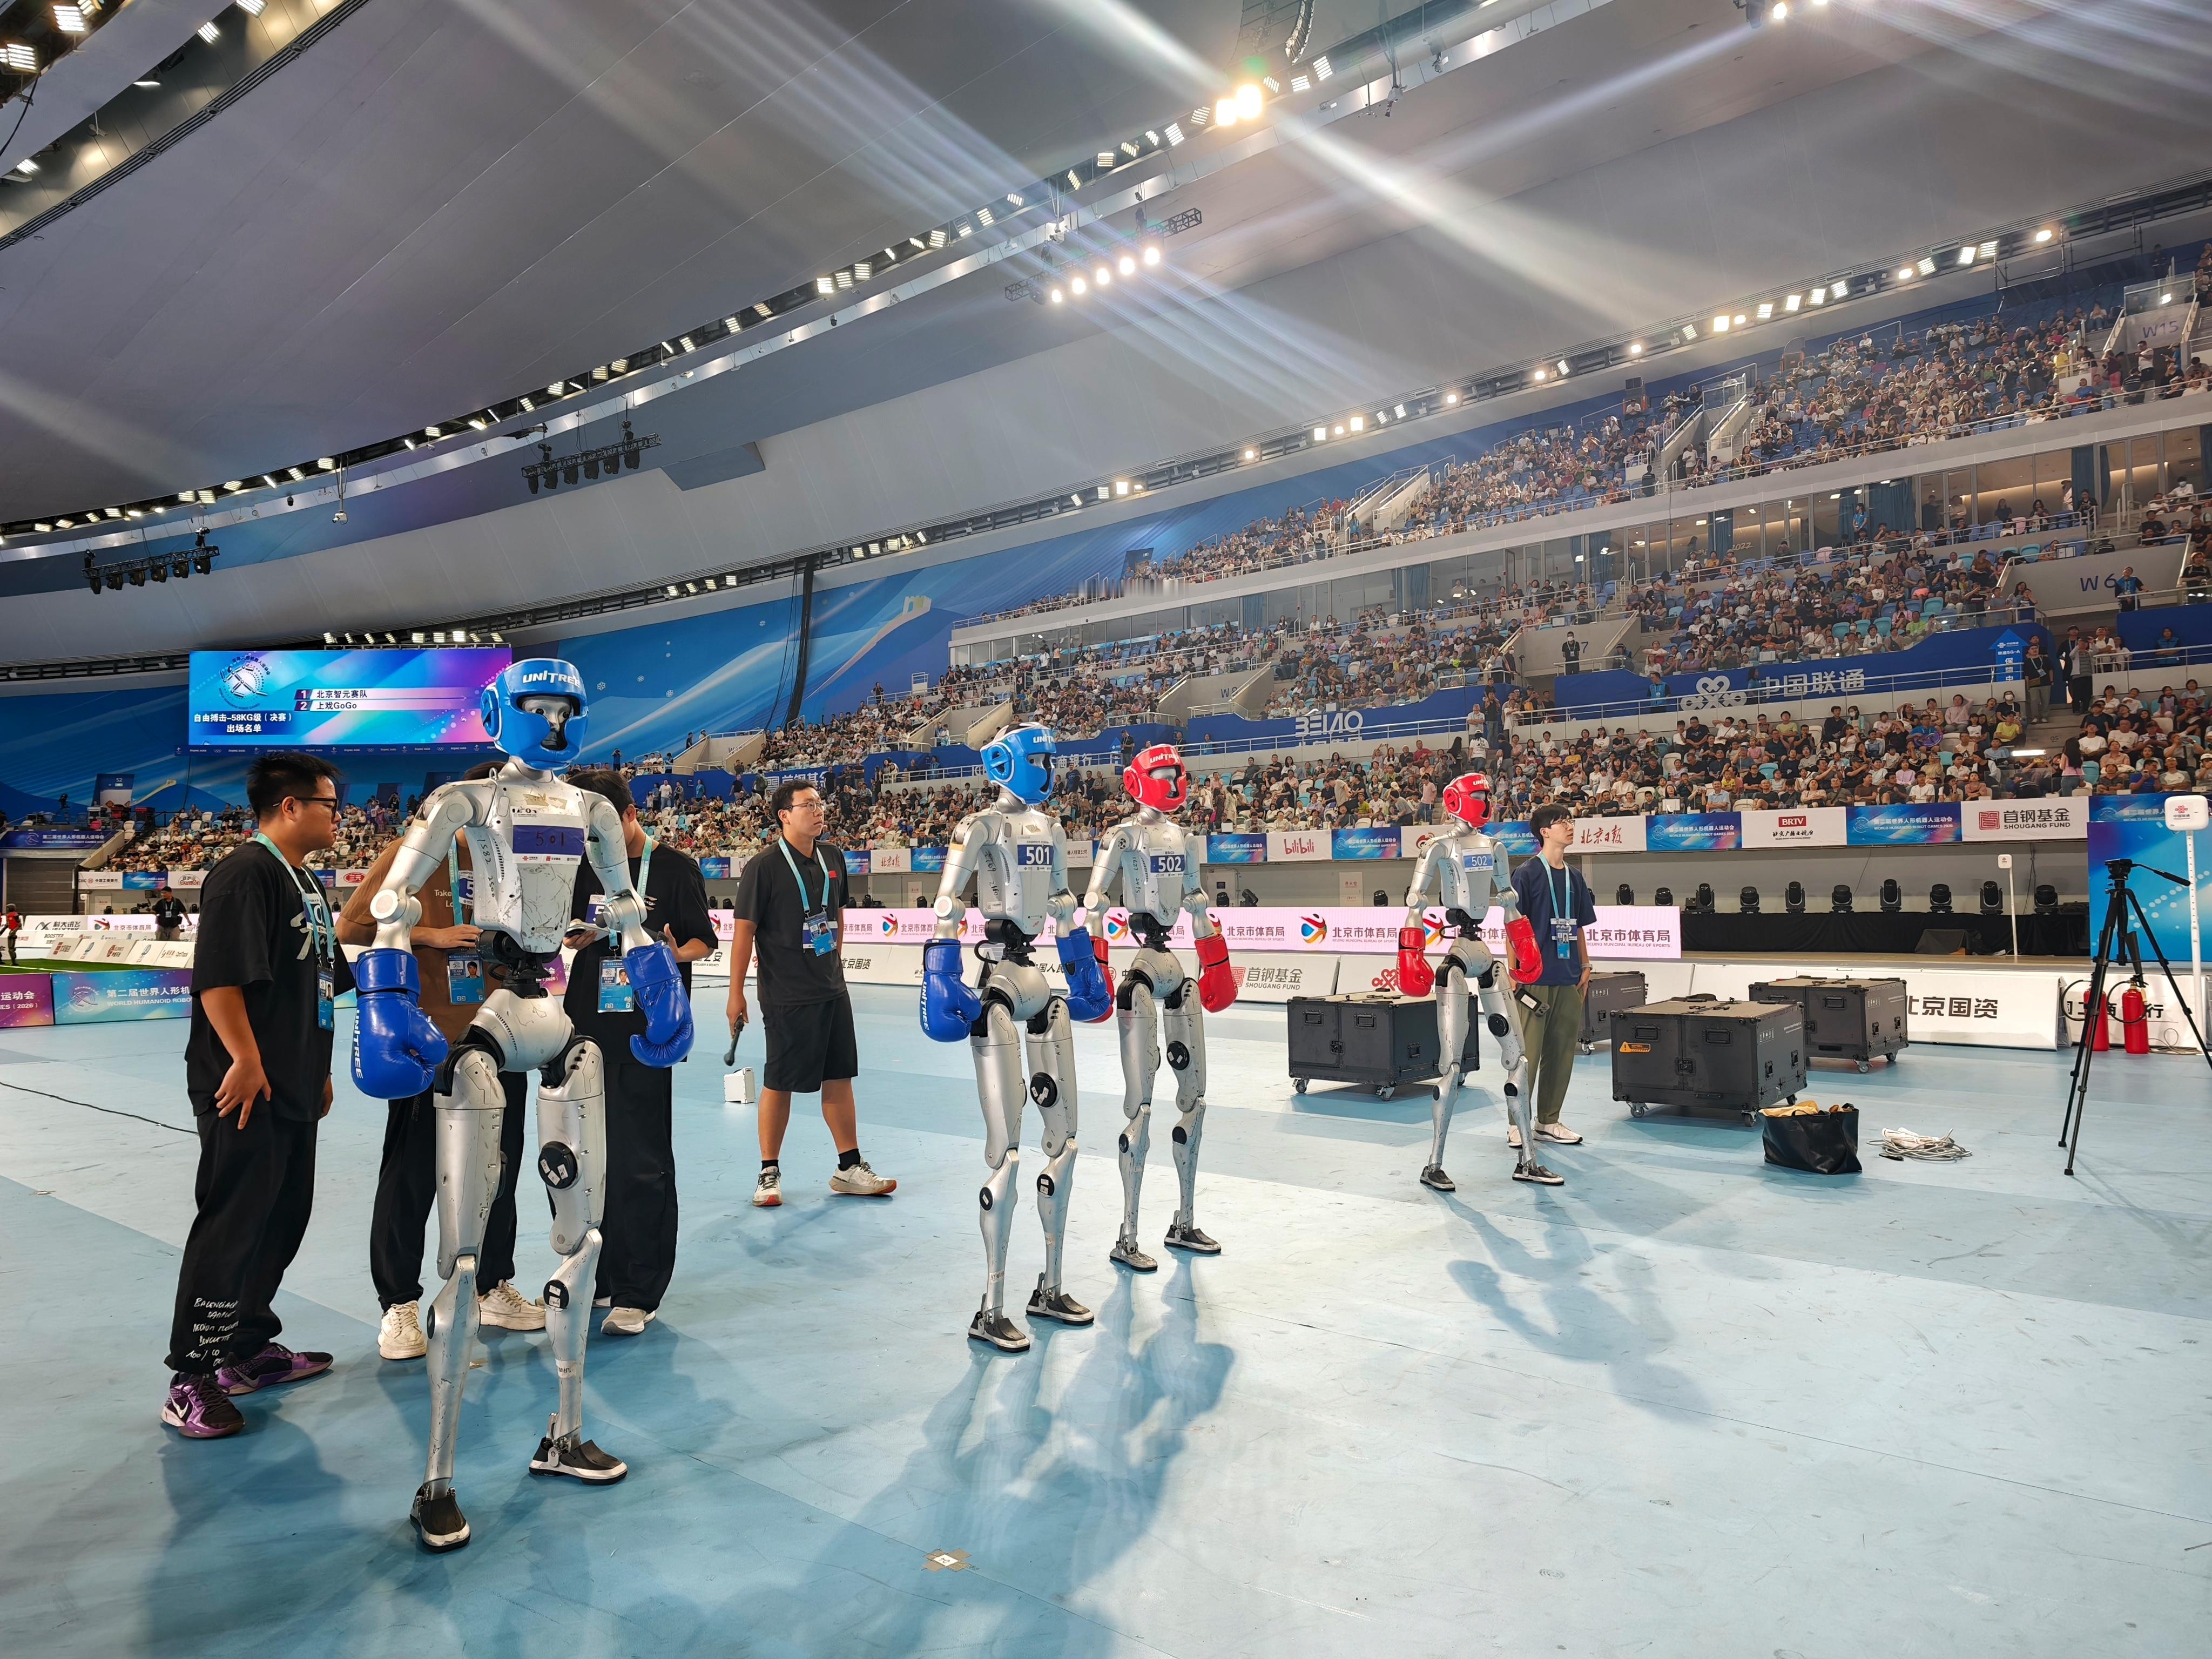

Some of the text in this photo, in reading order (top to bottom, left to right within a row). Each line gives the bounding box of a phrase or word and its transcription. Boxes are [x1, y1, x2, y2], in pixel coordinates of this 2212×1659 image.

[2143, 321, 2179, 338] W15
[523, 670, 580, 688] UNITREE
[1761, 668, 1865, 698] 中国联通
[301, 690, 307, 698] 1
[316, 690, 367, 699] 北京智元赛队
[300, 702, 307, 710] 2
[316, 701, 357, 710] 上戏GoGo
[227, 724, 262, 733] 出场名单
[1782, 818, 1804, 826] BRTV
[1874, 817, 1953, 825] 第二届世界人形机器人运动会
[2004, 809, 2070, 823] 首钢基金
[536, 831, 564, 847] 501
[1581, 825, 1622, 845] 北京日报
[1284, 838, 1314, 855] bilibili
[1027, 846, 1049, 865] 501
[1472, 855, 1487, 866] 502
[1158, 856, 1182, 872] 502
[1227, 926, 1285, 937] 北京市体育局
[1332, 927, 1397, 939] 北京市体育局
[1587, 929, 1670, 942] 北京市体育局
[1247, 967, 1303, 983] 首钢基金
[921, 982, 930, 1031] UNITREE
[353, 1010, 363, 1078] UNITREE
